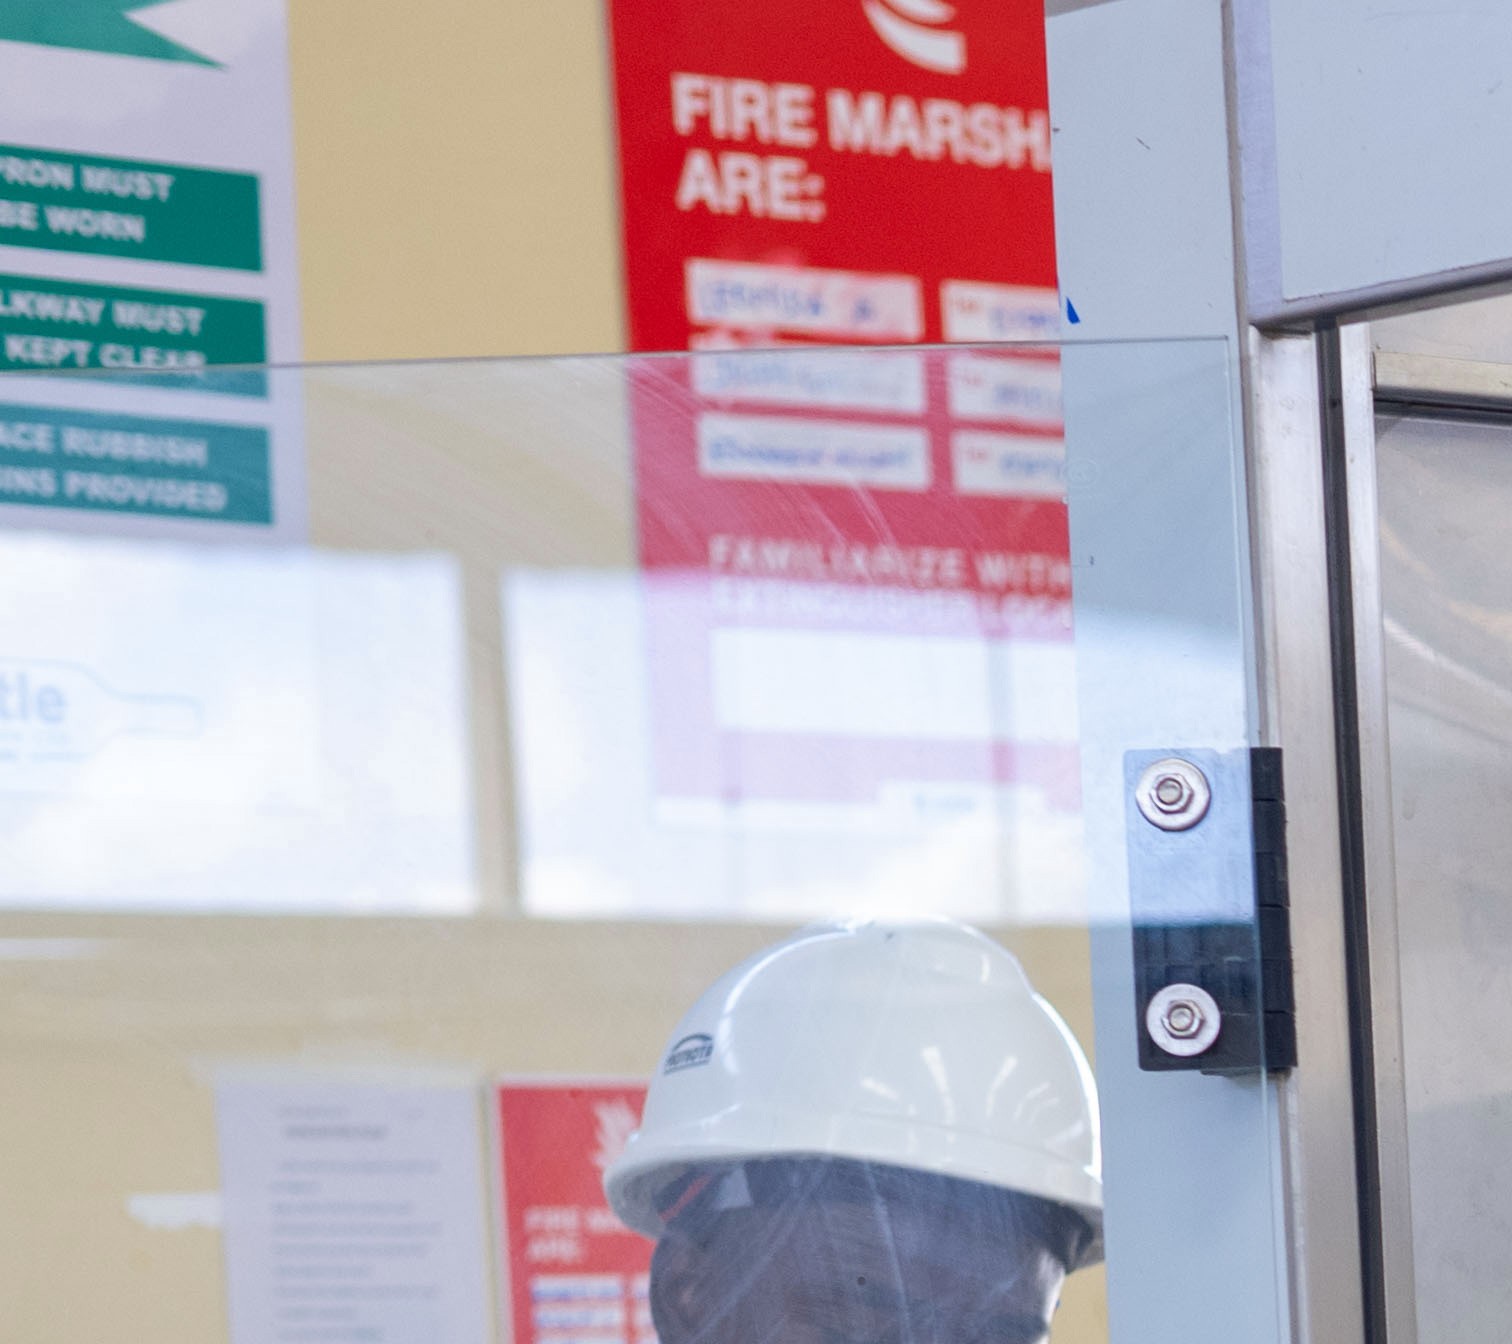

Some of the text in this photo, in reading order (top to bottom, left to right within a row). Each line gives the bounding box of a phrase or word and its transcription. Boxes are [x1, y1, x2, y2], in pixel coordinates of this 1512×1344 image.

[673, 73, 1054, 171] FIRE MARSH
[82, 165, 175, 201] MUST
[676, 157, 827, 222] ARE:
[45, 206, 147, 242] WORN
[112, 299, 206, 336] MUST
[5, 333, 206, 378] KEPT CLEAR
[61, 424, 209, 468] RUBBISH
[63, 470, 228, 513] PROVIDED
